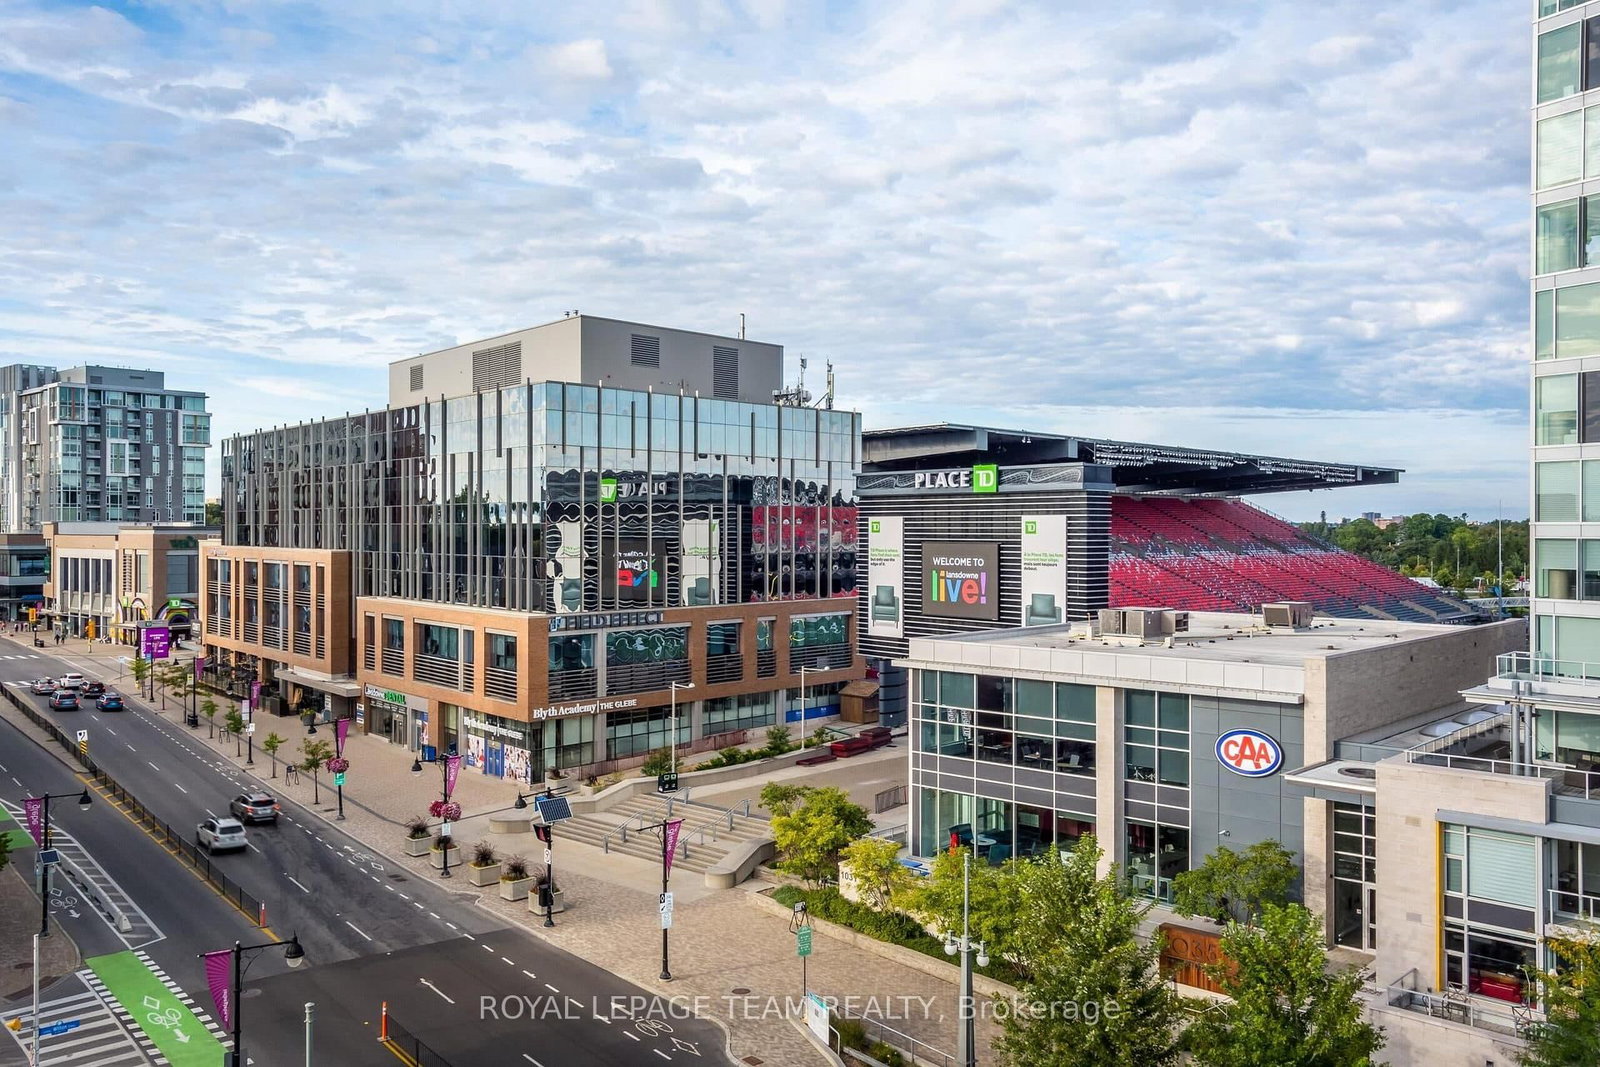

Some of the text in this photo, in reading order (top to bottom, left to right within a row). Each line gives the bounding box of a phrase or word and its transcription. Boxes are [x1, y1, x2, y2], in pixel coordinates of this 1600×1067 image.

[914, 469, 995, 489] PLACE TD
[932, 556, 985, 567] WELCOME TO
[946, 571, 979, 580] lansdowne
[932, 570, 987, 605] live!
[565, 614, 607, 630] FIELD
[609, 611, 664, 628] EFFECT
[533, 699, 637, 720] Blyth Academy THE GLEBE
[1223, 736, 1271, 769] CAA
